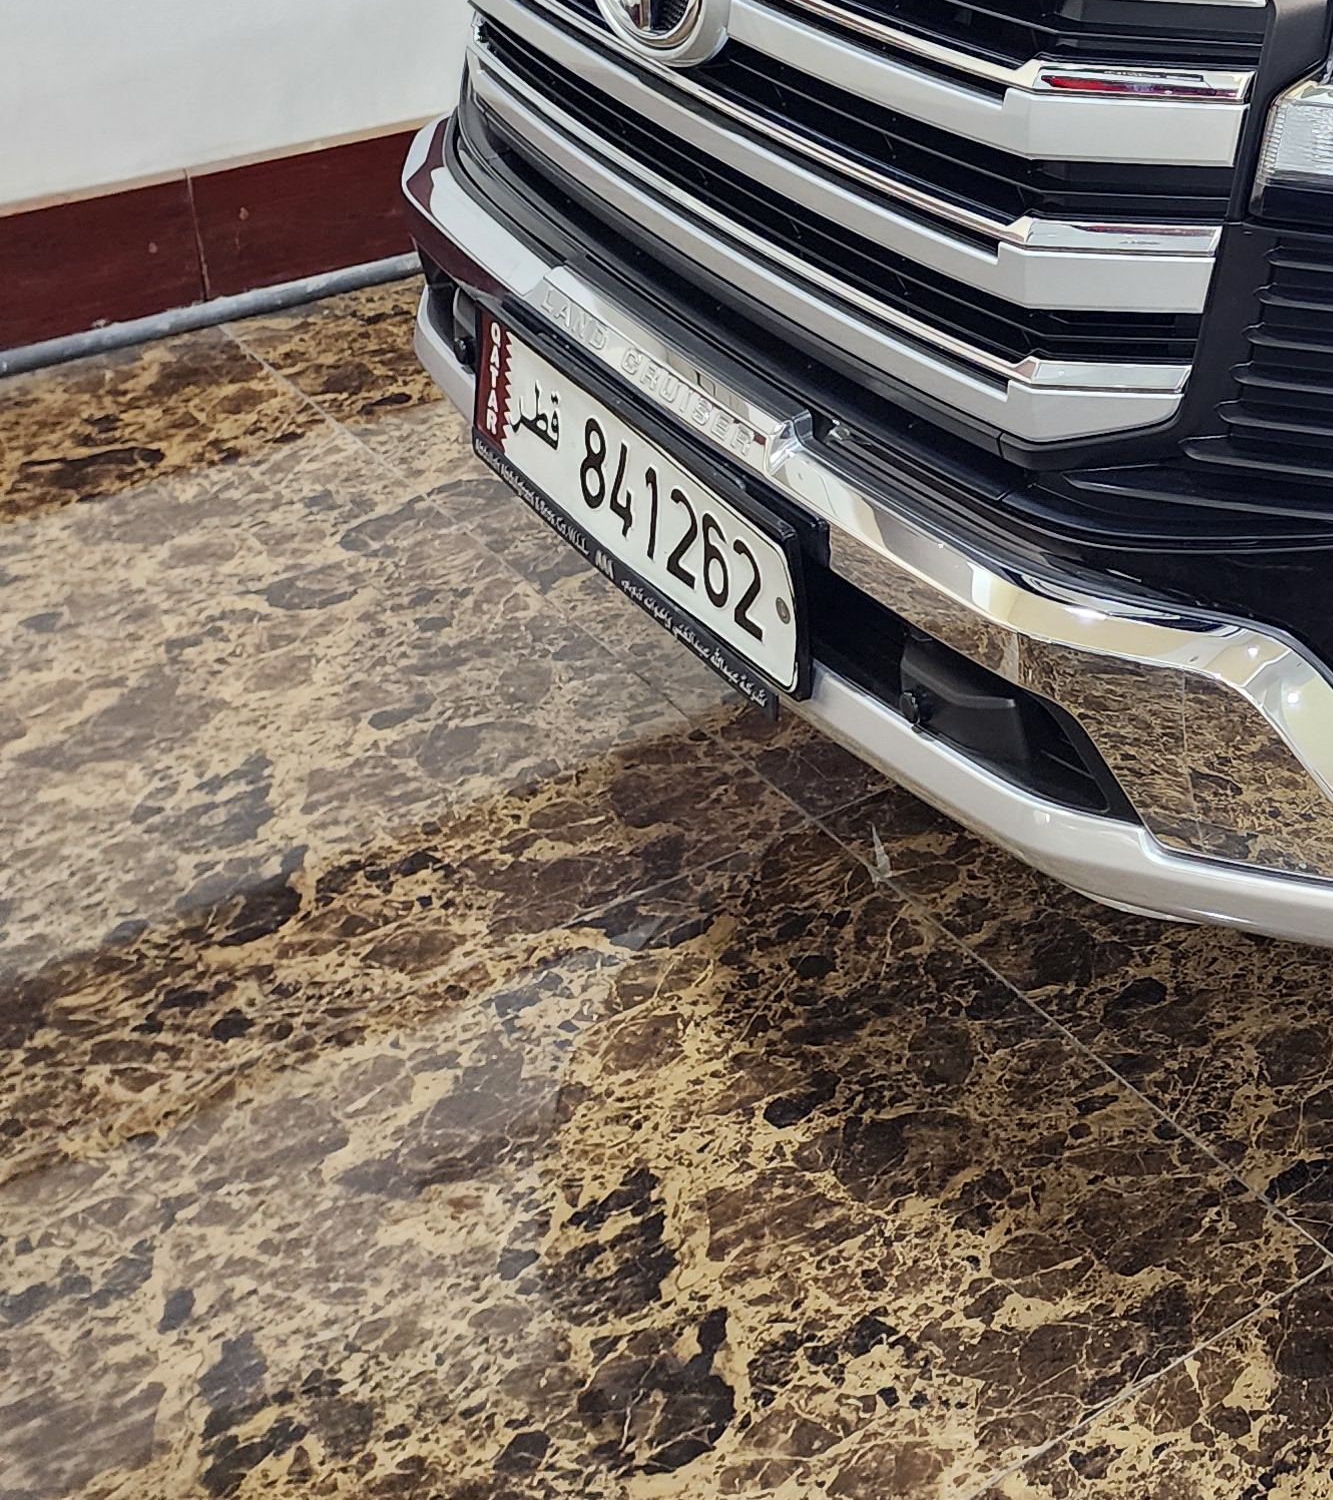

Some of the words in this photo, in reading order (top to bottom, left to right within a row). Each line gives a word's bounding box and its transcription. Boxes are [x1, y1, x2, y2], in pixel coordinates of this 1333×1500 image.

[486, 321, 502, 437] QATAR
[508, 379, 562, 452] قطر
[539, 289, 609, 351] LAND
[620, 347, 756, 458] CRUISER
[579, 416, 765, 644] 841262
